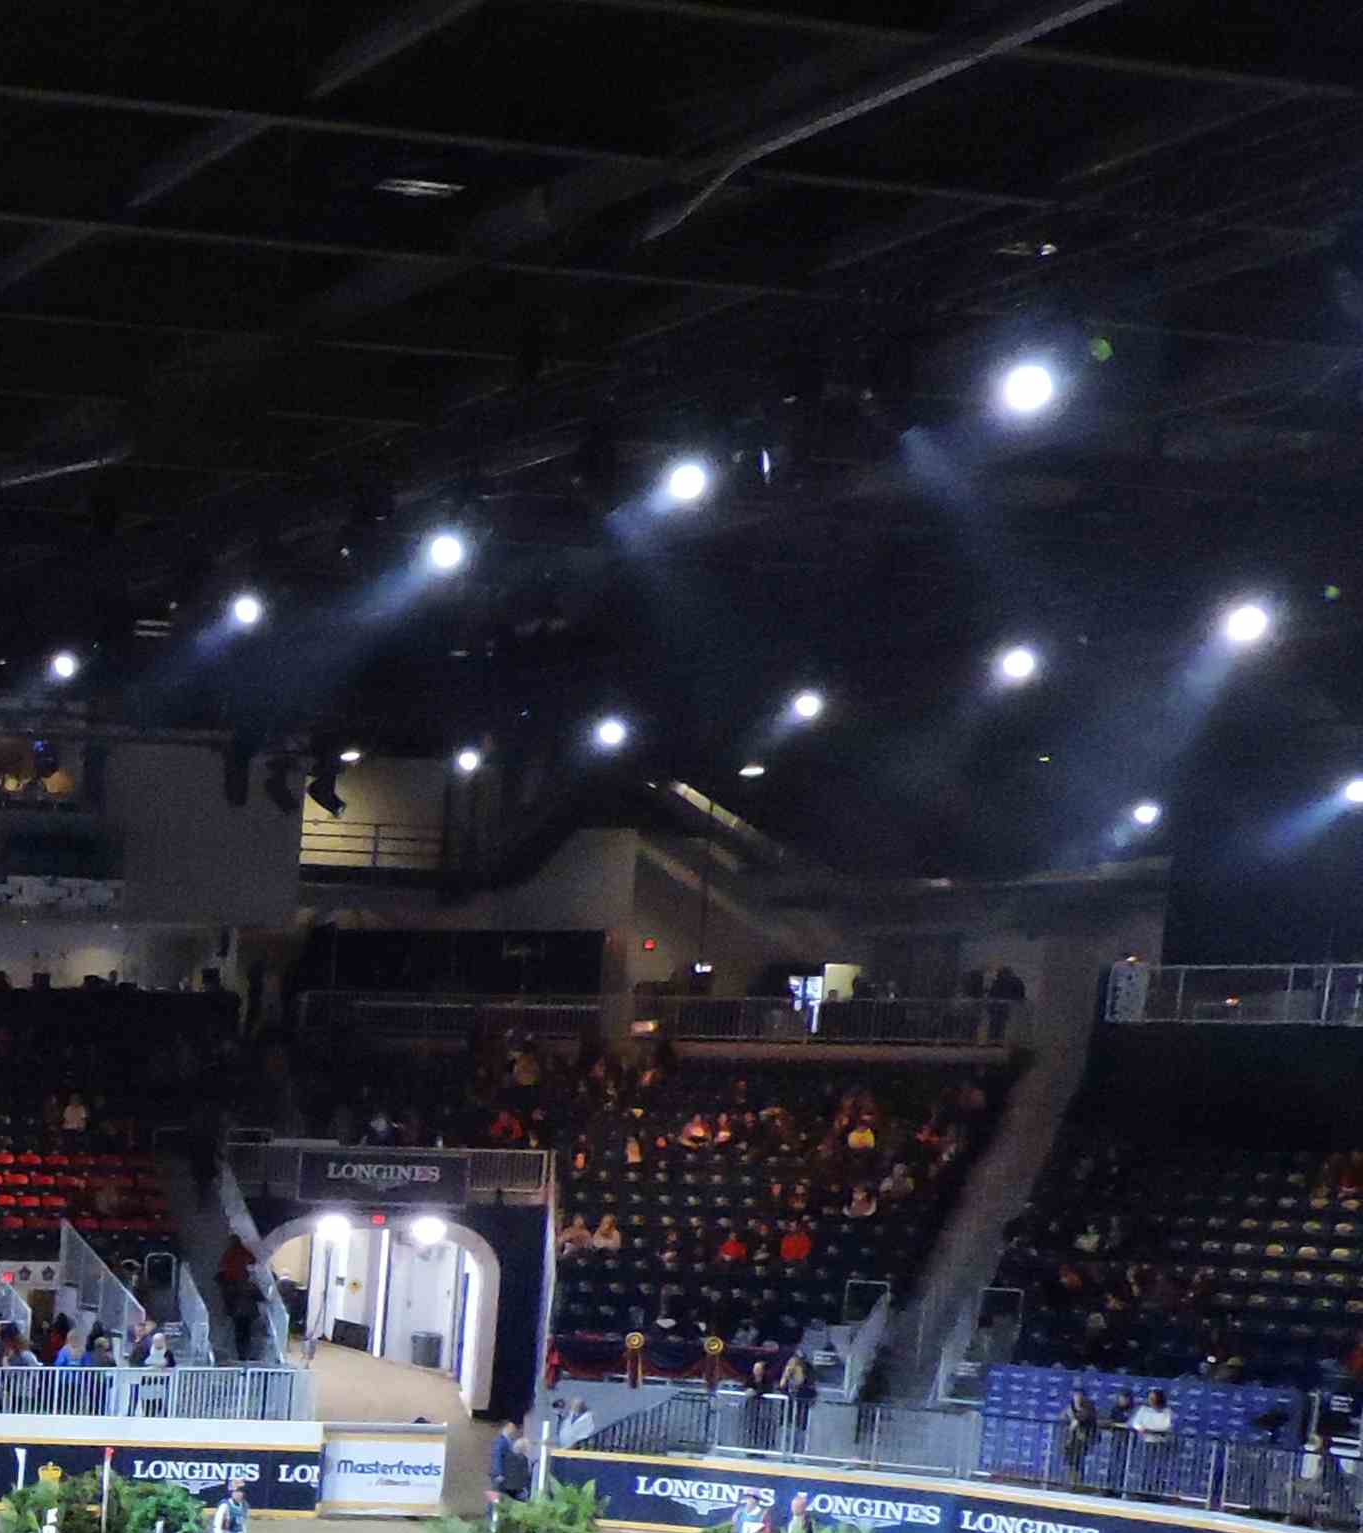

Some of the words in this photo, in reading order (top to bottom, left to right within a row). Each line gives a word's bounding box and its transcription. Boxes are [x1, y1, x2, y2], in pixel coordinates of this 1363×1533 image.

[328, 1162, 441, 1182] LONGINES
[133, 1460, 259, 1482] LONGINES
[337, 1459, 443, 1476] Masterfeeds
